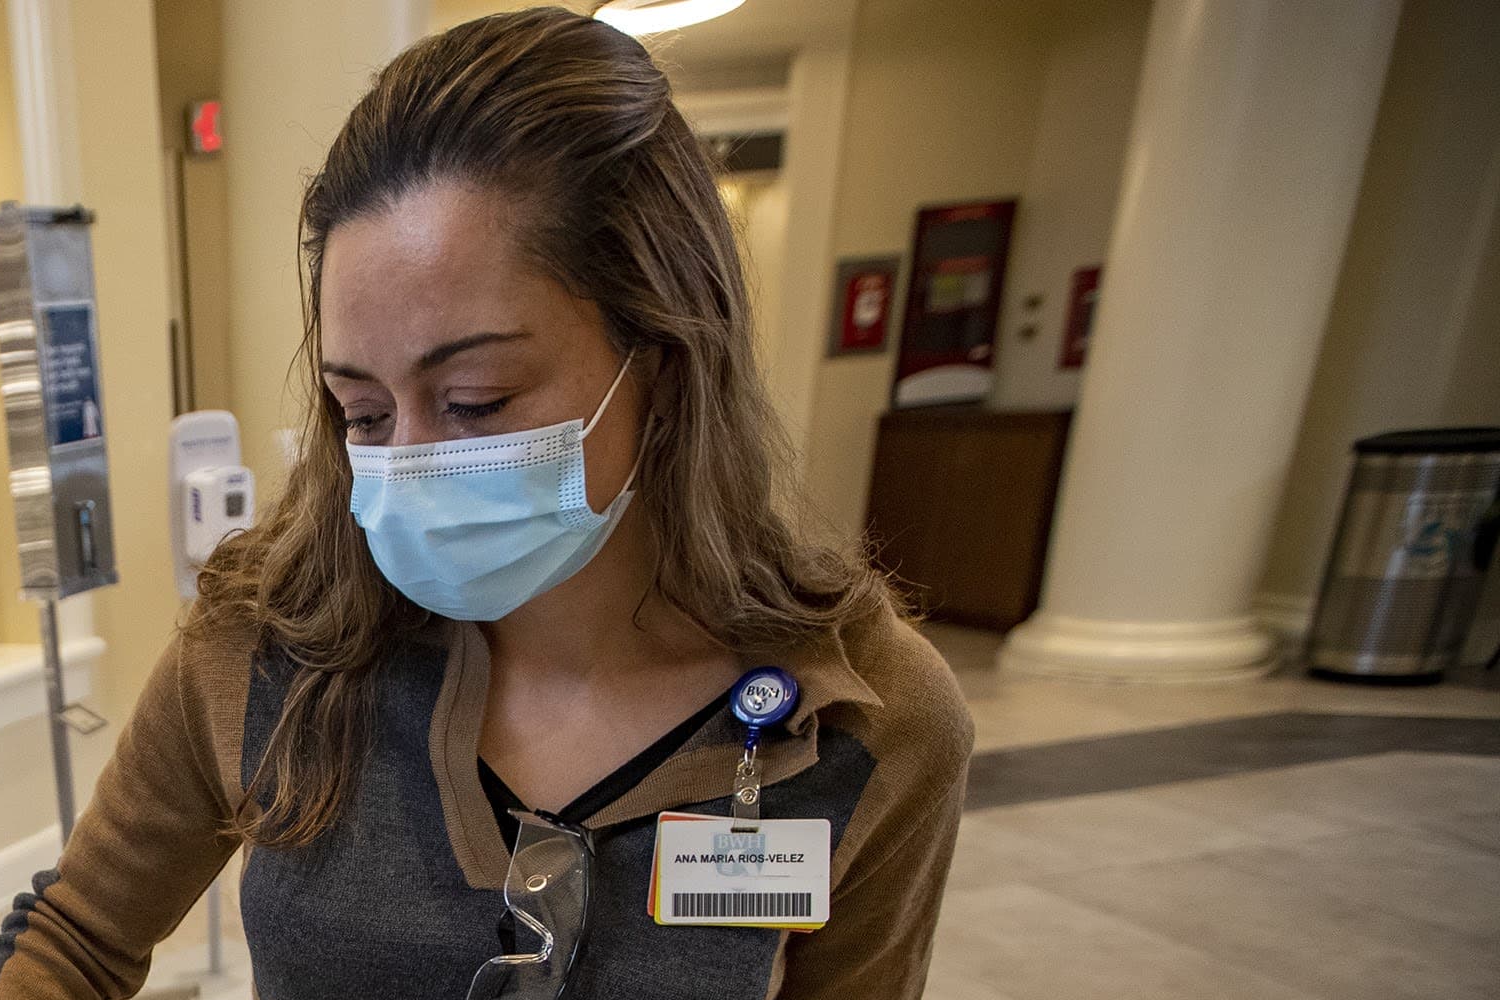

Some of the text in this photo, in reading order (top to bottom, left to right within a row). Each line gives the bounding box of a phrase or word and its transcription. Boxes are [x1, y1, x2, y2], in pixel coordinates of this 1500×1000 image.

[747, 685, 780, 698] BWH
[718, 834, 762, 849] BWH
[674, 853, 804, 863] ANA MARIA RIOS-VELEZ
